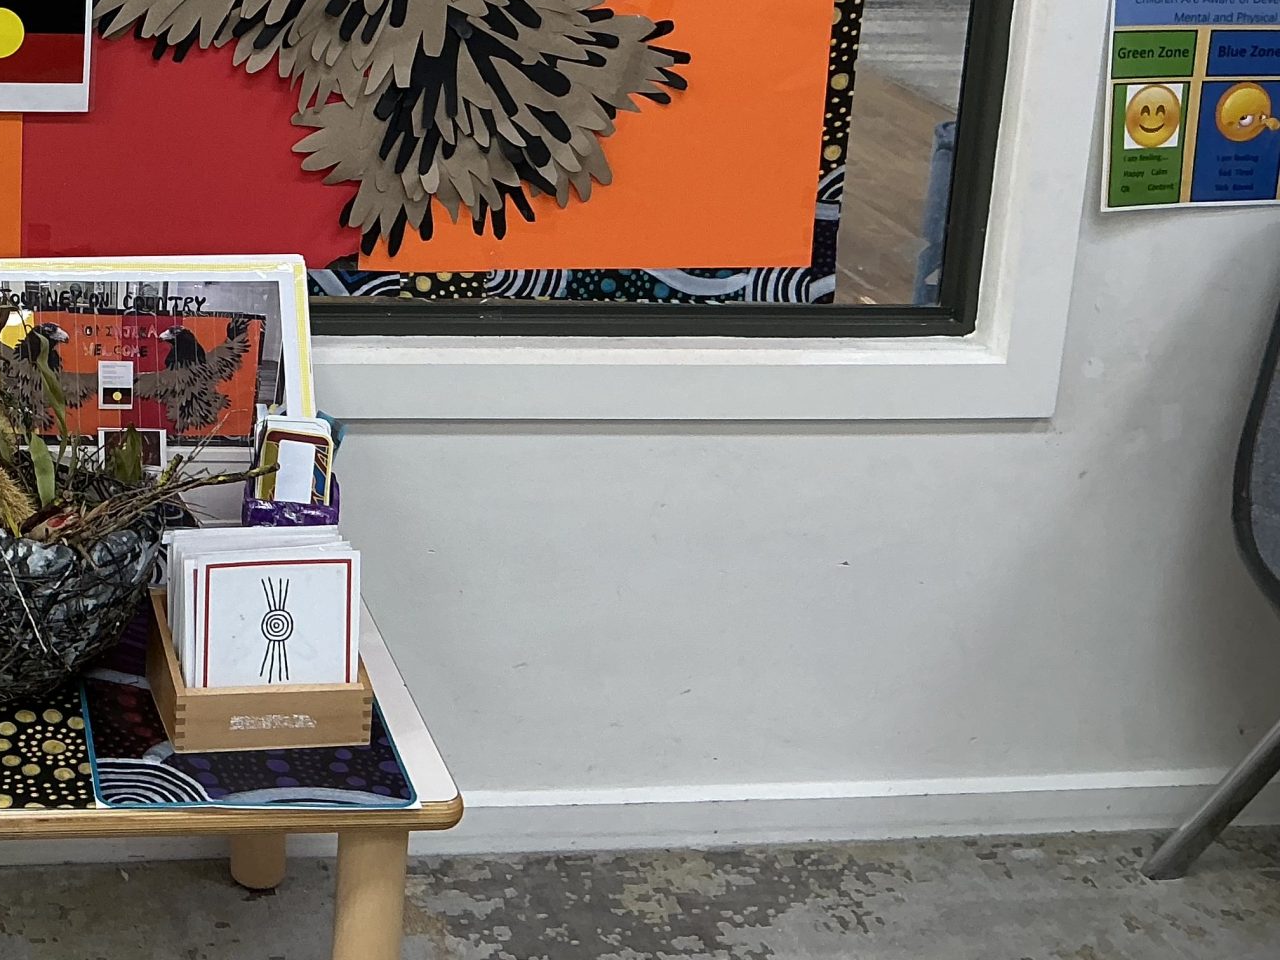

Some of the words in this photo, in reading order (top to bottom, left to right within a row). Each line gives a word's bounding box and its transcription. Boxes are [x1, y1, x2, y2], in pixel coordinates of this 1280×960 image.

[1173, 11, 1211, 23] Mental
[1213, 11, 1234, 23] and
[1236, 11, 1278, 25] Physical
[1117, 47, 1154, 59] Green
[1158, 46, 1190, 58] Zone
[1218, 45, 1247, 58] Blue
[1250, 45, 1280, 58] Zone
[1123, 170, 1145, 178] Happy
[1151, 168, 1168, 176] Calm
[1147, 182, 1175, 191] Content
[88, 291, 110, 308] ON
[123, 294, 207, 312] COUNTRY
